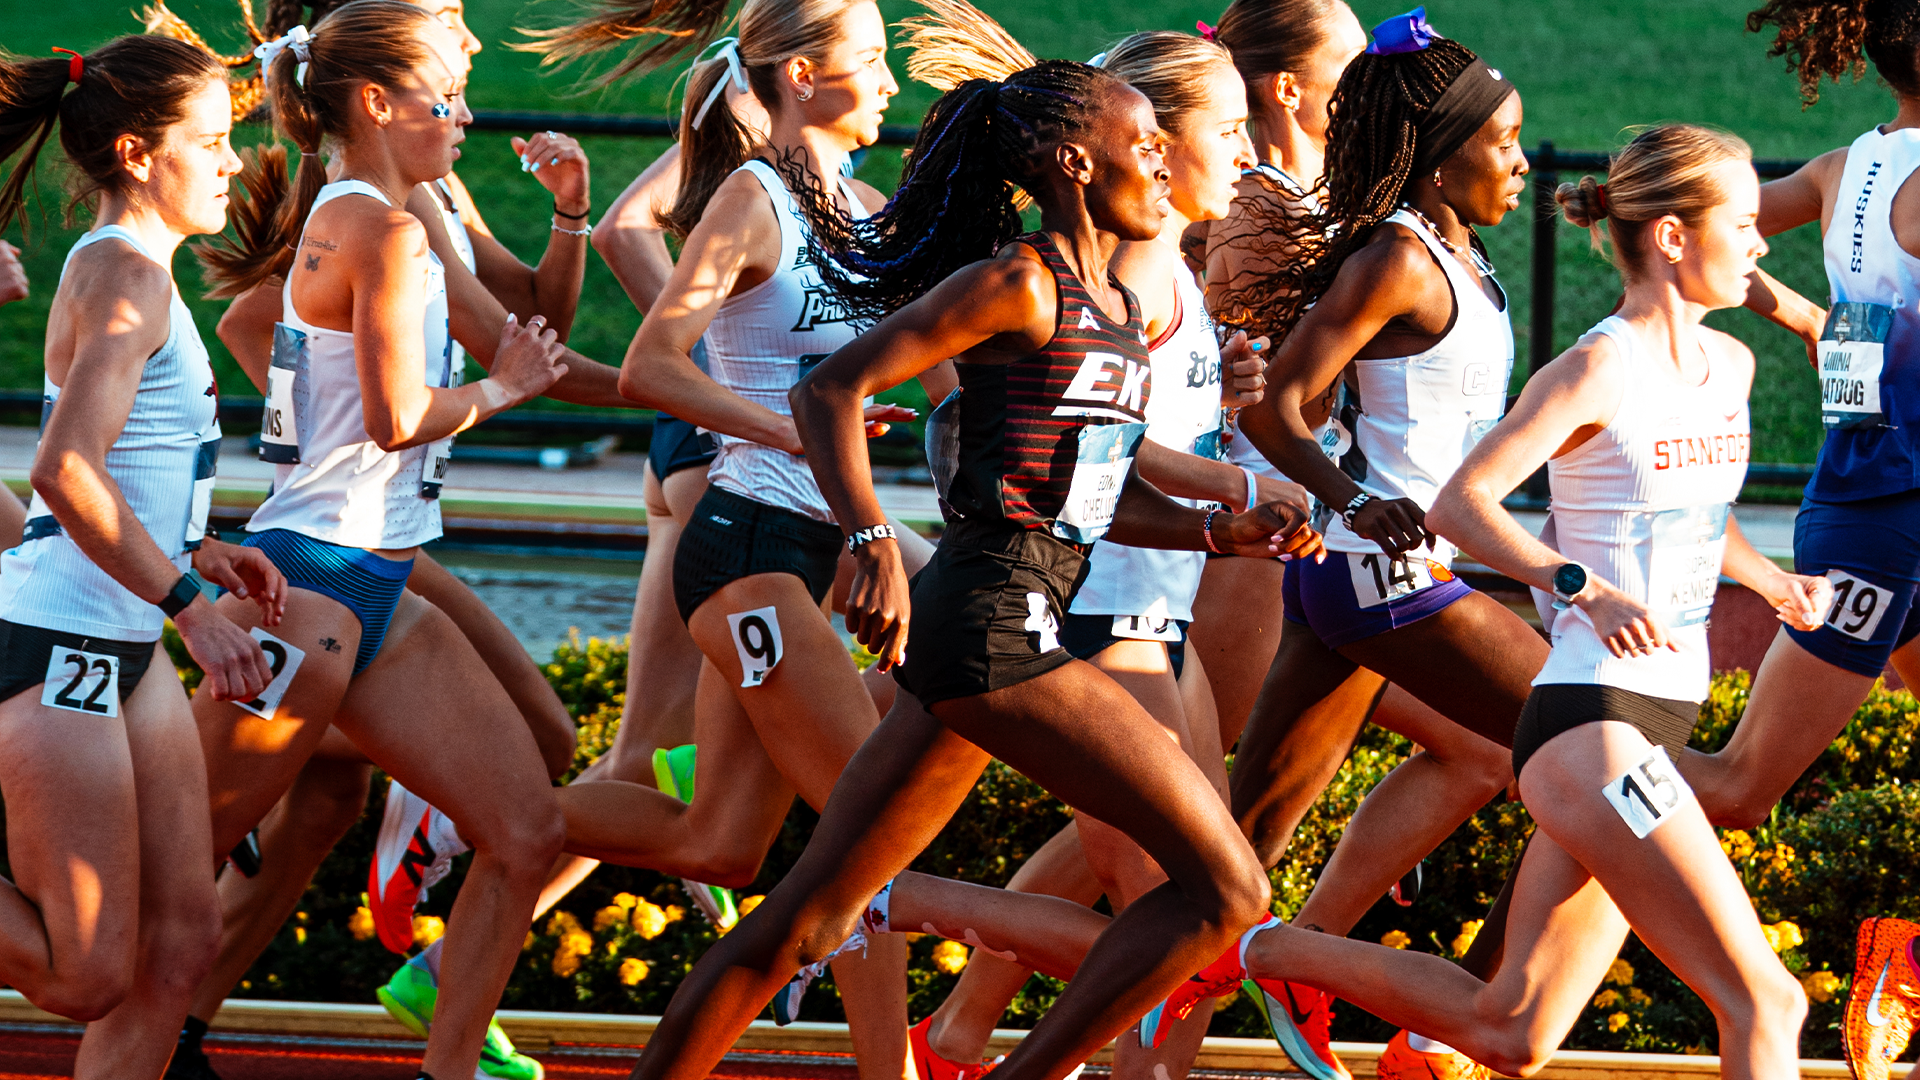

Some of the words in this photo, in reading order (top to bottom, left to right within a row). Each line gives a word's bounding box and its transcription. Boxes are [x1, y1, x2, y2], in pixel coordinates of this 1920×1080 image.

[1851, 161, 1882, 274] HUSKIES
[1823, 351, 1852, 371] AMINA
[1360, 553, 1417, 600] 14
[1827, 579, 1878, 633] 19
[738, 614, 776, 668] 9
[54, 653, 112, 714] 22
[1621, 755, 1679, 820] 15
